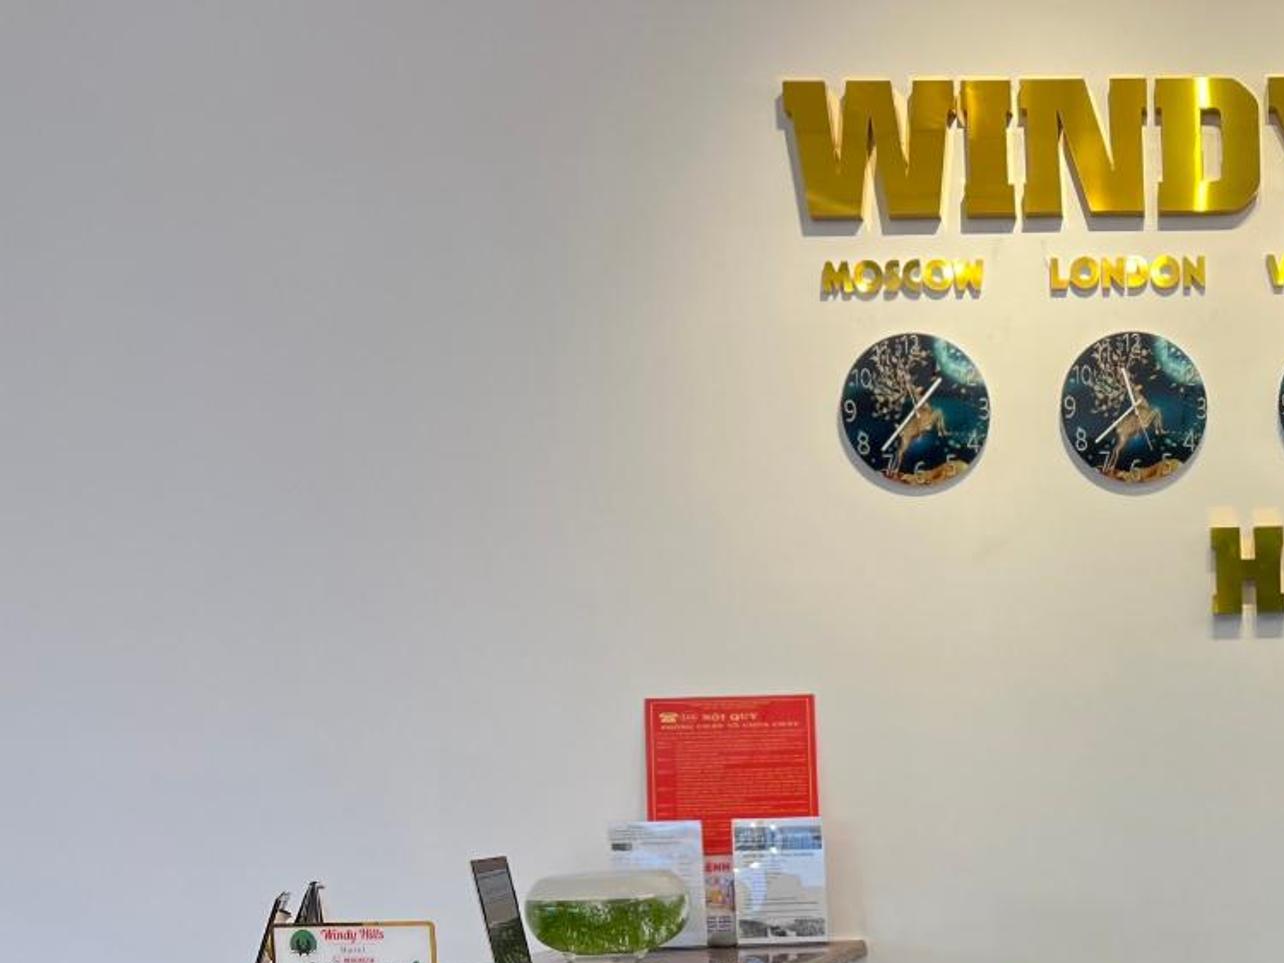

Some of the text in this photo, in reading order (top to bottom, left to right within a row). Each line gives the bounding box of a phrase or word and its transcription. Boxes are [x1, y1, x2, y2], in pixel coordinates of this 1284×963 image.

[820, 258, 984, 295] MOSCOW
[1049, 255, 1206, 292] LONDON
[851, 368, 872, 388] 10
[1073, 365, 1092, 385] 10
[843, 400, 857, 422] 9
[979, 398, 990, 420] 3
[1064, 395, 1076, 419] 9
[1196, 397, 1206, 419] 3
[857, 431, 870, 455] 8
[967, 429, 980, 453] 4
[1075, 427, 1088, 451] 8
[1183, 429, 1195, 451] 4
[321, 929, 384, 944] Windy Hills
